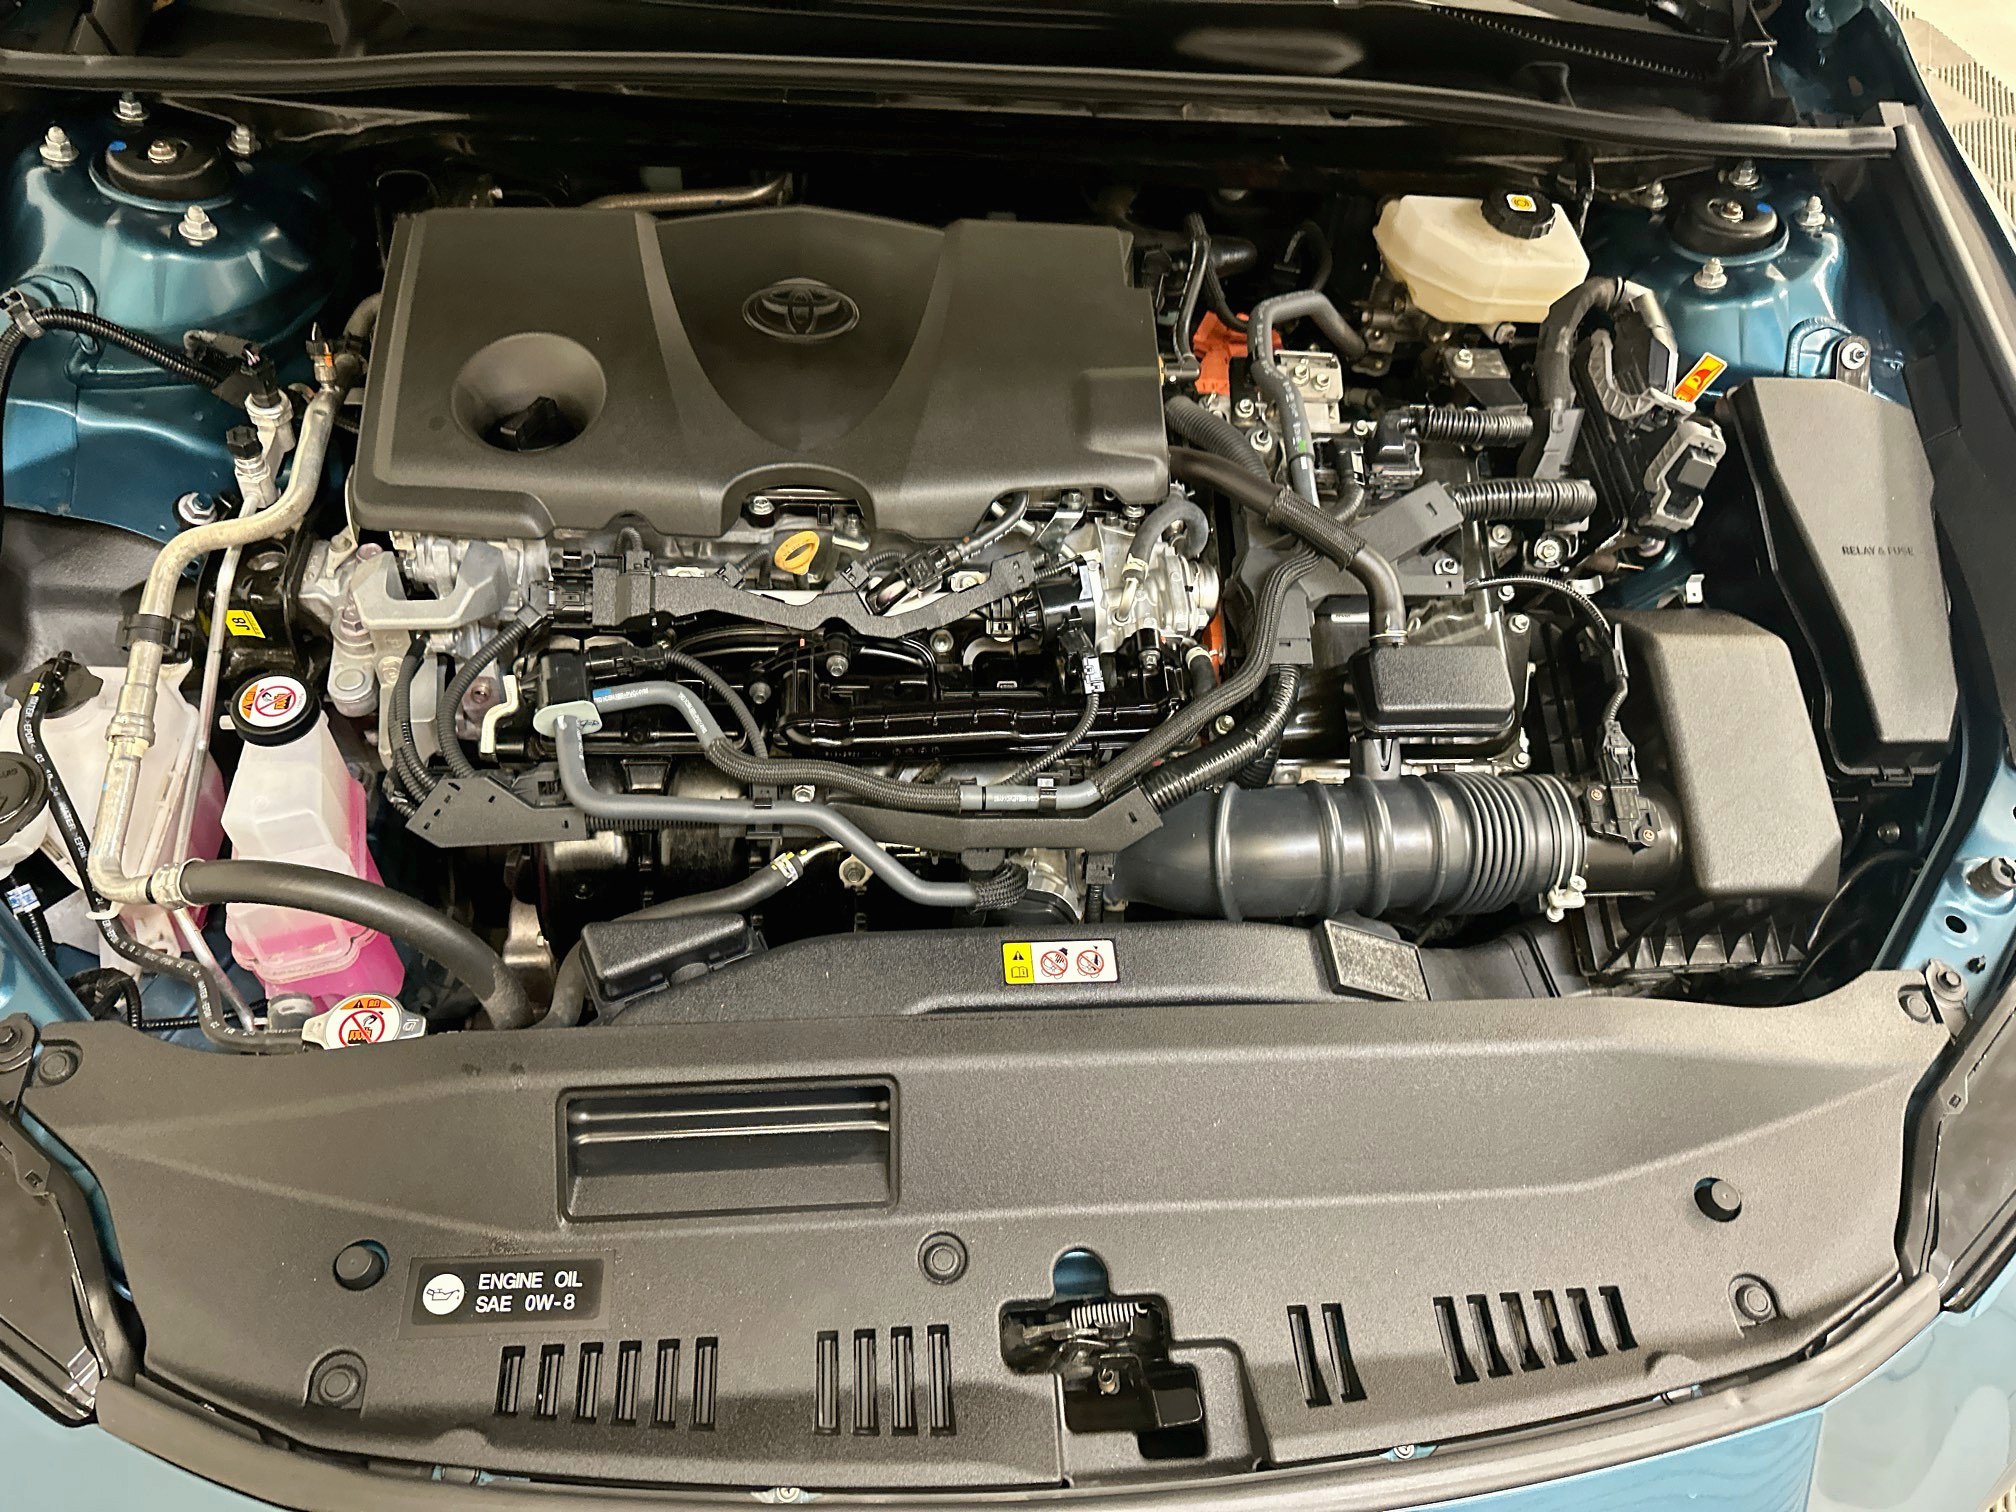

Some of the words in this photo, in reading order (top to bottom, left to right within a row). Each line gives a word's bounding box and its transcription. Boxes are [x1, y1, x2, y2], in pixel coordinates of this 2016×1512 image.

[1841, 545, 1875, 556] RELAY
[231, 617, 250, 631] J8
[478, 1271, 544, 1291] ENGINE
[554, 1270, 583, 1289] OIL
[475, 1295, 513, 1313] SAE
[524, 1293, 576, 1312] 0W-8
